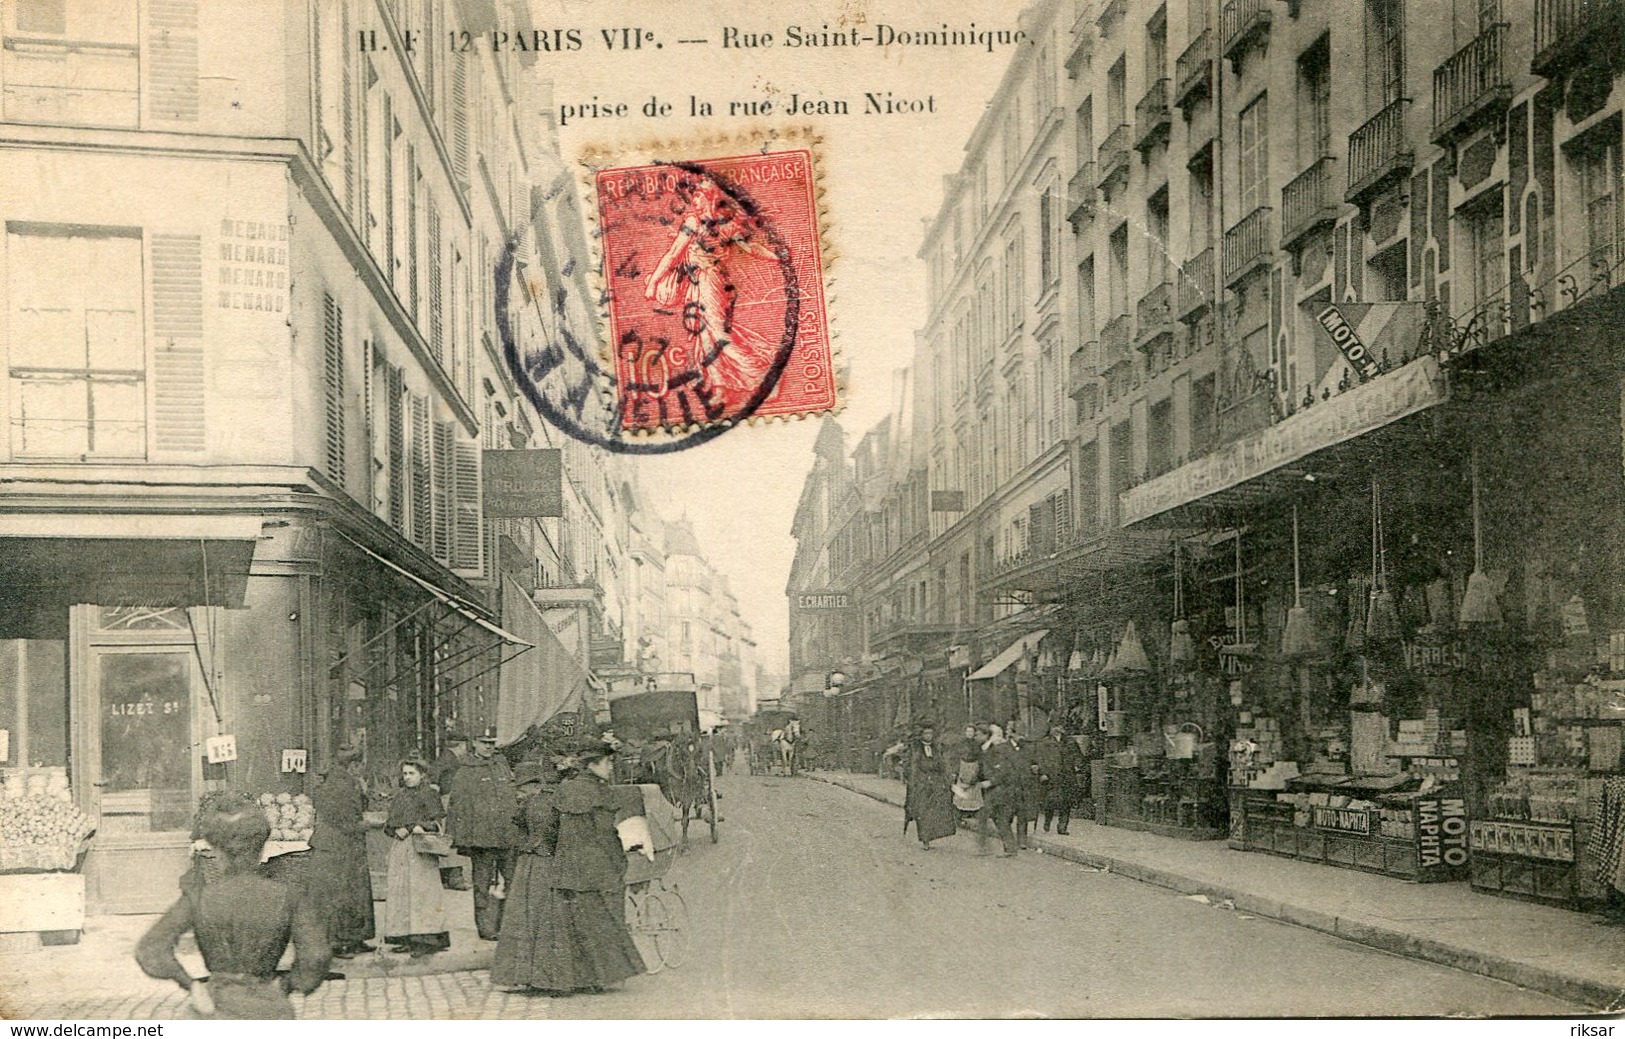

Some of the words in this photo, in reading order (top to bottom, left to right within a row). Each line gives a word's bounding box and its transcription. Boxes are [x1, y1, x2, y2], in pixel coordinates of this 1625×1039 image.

[799, 311, 824, 395] POSTES
[1418, 800, 1441, 867] NAPHTA
[1441, 798, 1468, 866] MOTO
